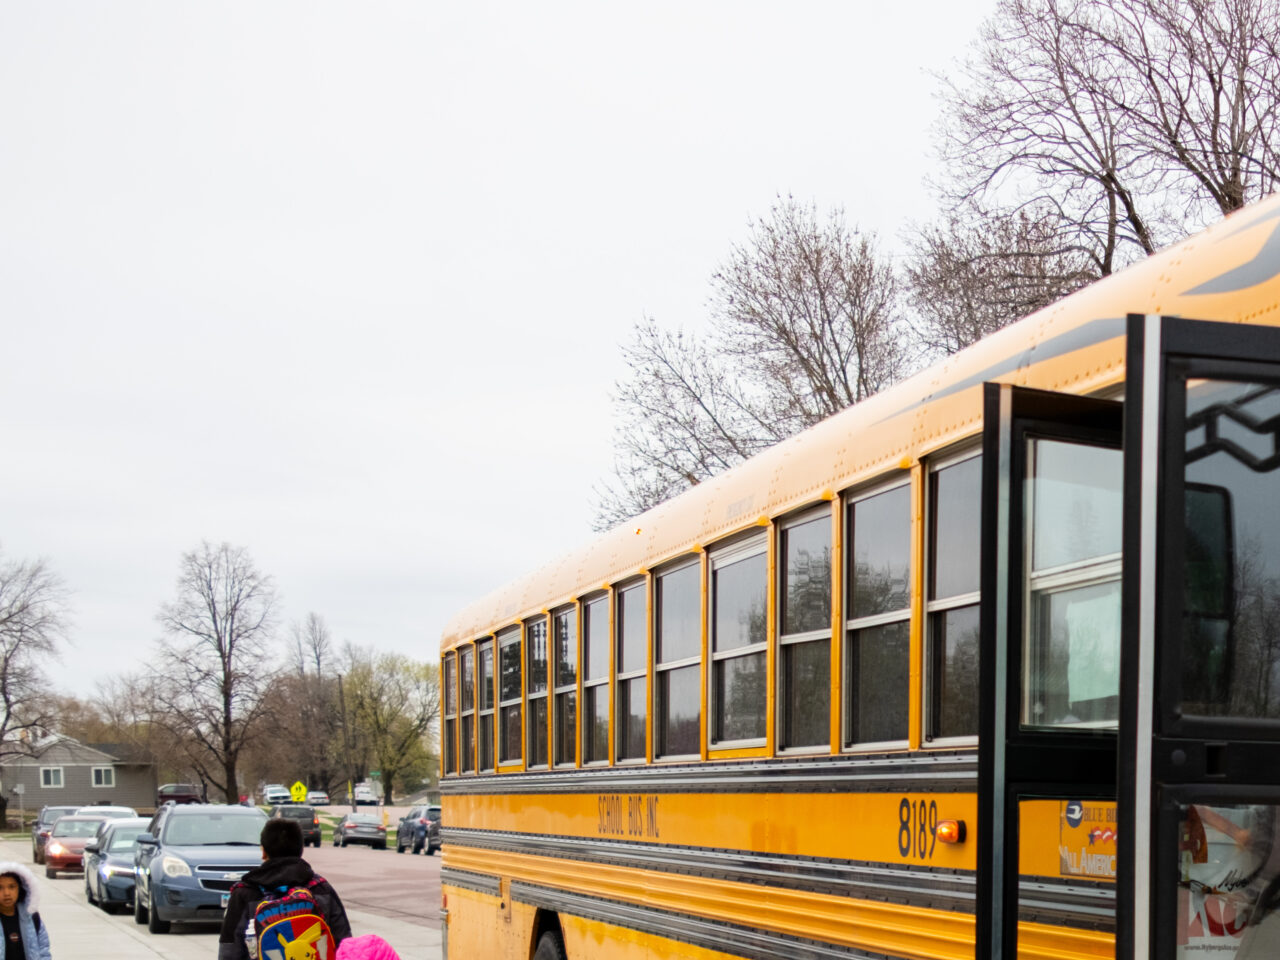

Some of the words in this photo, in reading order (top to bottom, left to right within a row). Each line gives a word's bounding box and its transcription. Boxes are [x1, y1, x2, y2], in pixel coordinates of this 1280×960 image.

[598, 795, 624, 835] SCHOOL
[628, 796, 643, 837] BUS
[646, 796, 660, 838] INC
[898, 797, 938, 859] 8189
